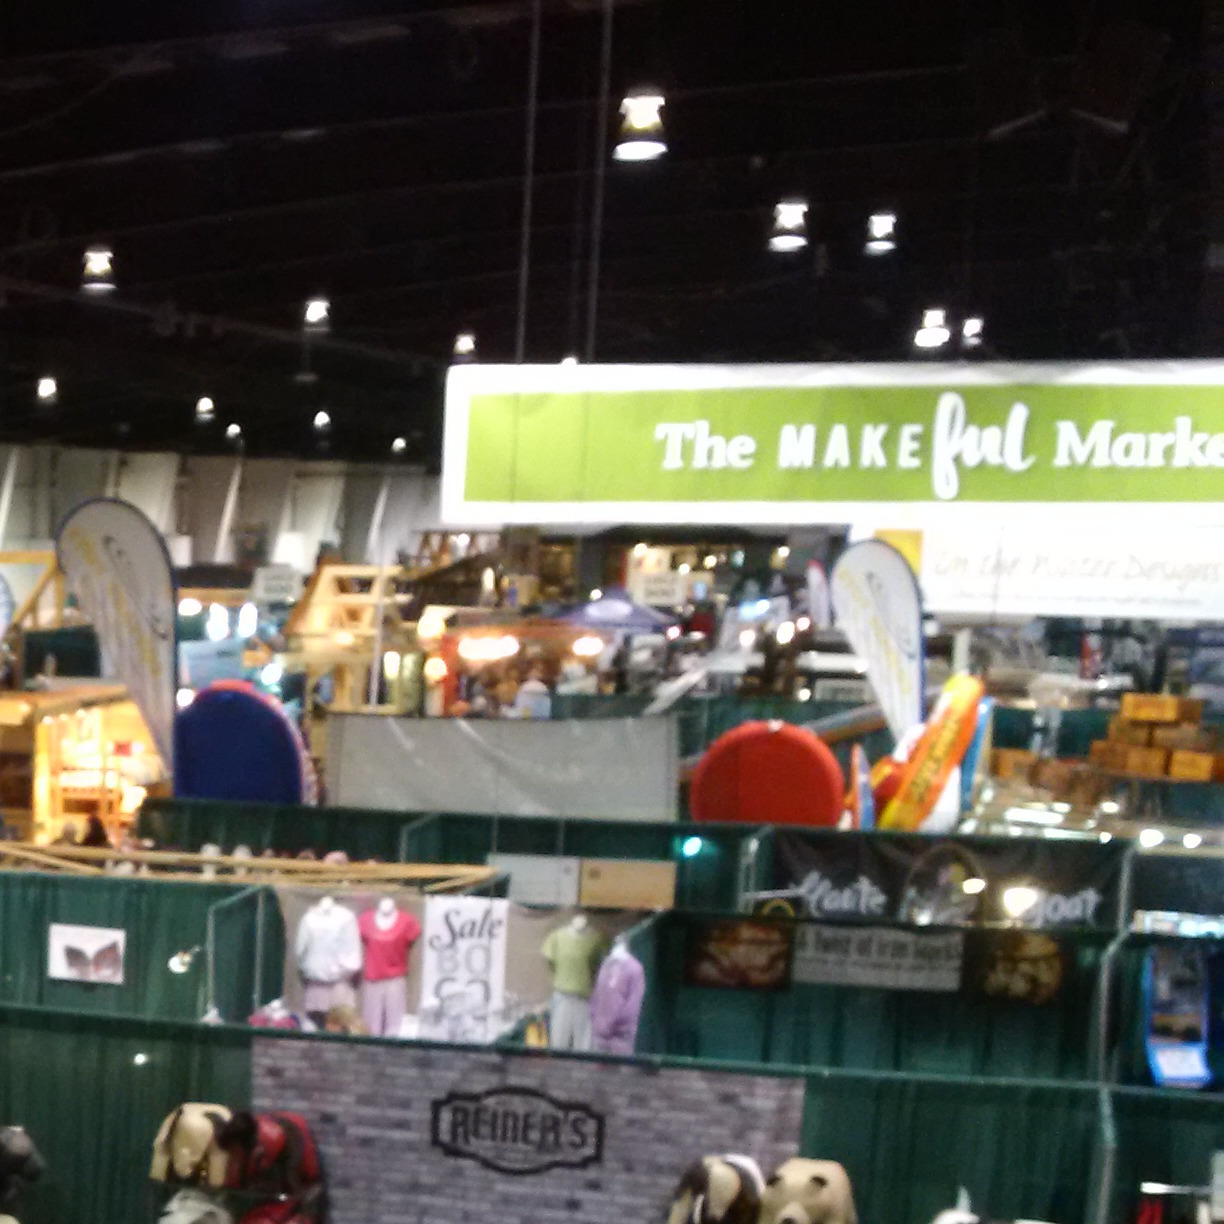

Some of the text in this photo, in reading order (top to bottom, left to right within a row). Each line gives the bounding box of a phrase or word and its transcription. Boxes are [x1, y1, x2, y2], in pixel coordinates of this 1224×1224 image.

[655, 420, 758, 470] The
[429, 907, 503, 950] Sale
[449, 1101, 591, 1154] REINER'S
